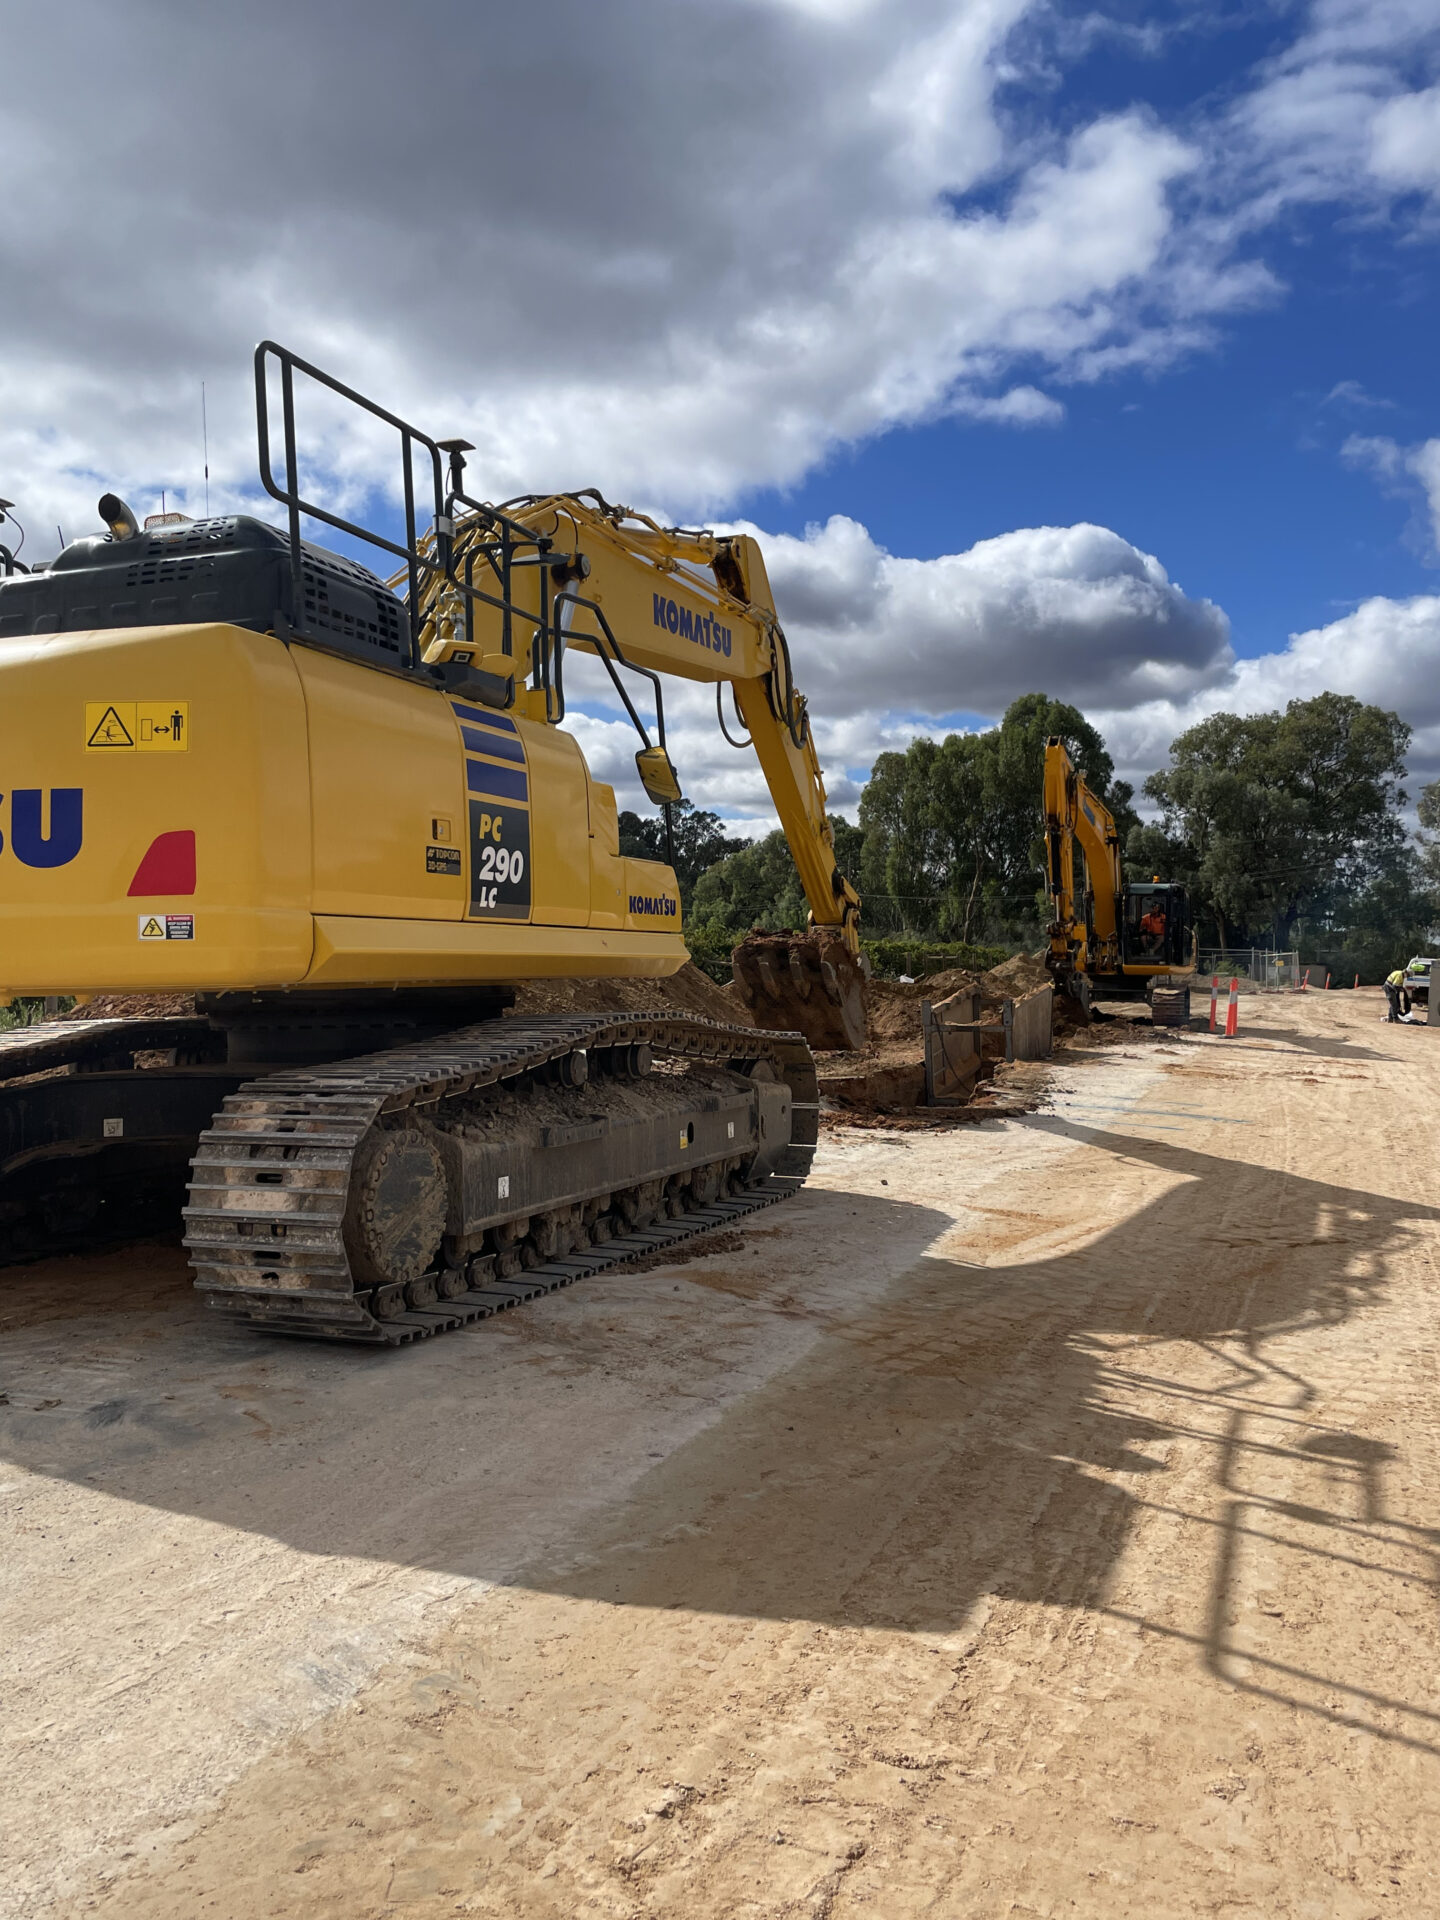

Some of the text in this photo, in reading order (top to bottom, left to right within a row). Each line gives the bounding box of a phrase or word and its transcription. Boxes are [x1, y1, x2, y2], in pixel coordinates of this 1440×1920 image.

[653, 592, 732, 658] KOMATSU
[0, 788, 83, 869] U
[479, 813, 503, 842] PC
[479, 846, 524, 884] 290
[479, 886, 498, 908] LC
[629, 893, 676, 916] KOMATSU
